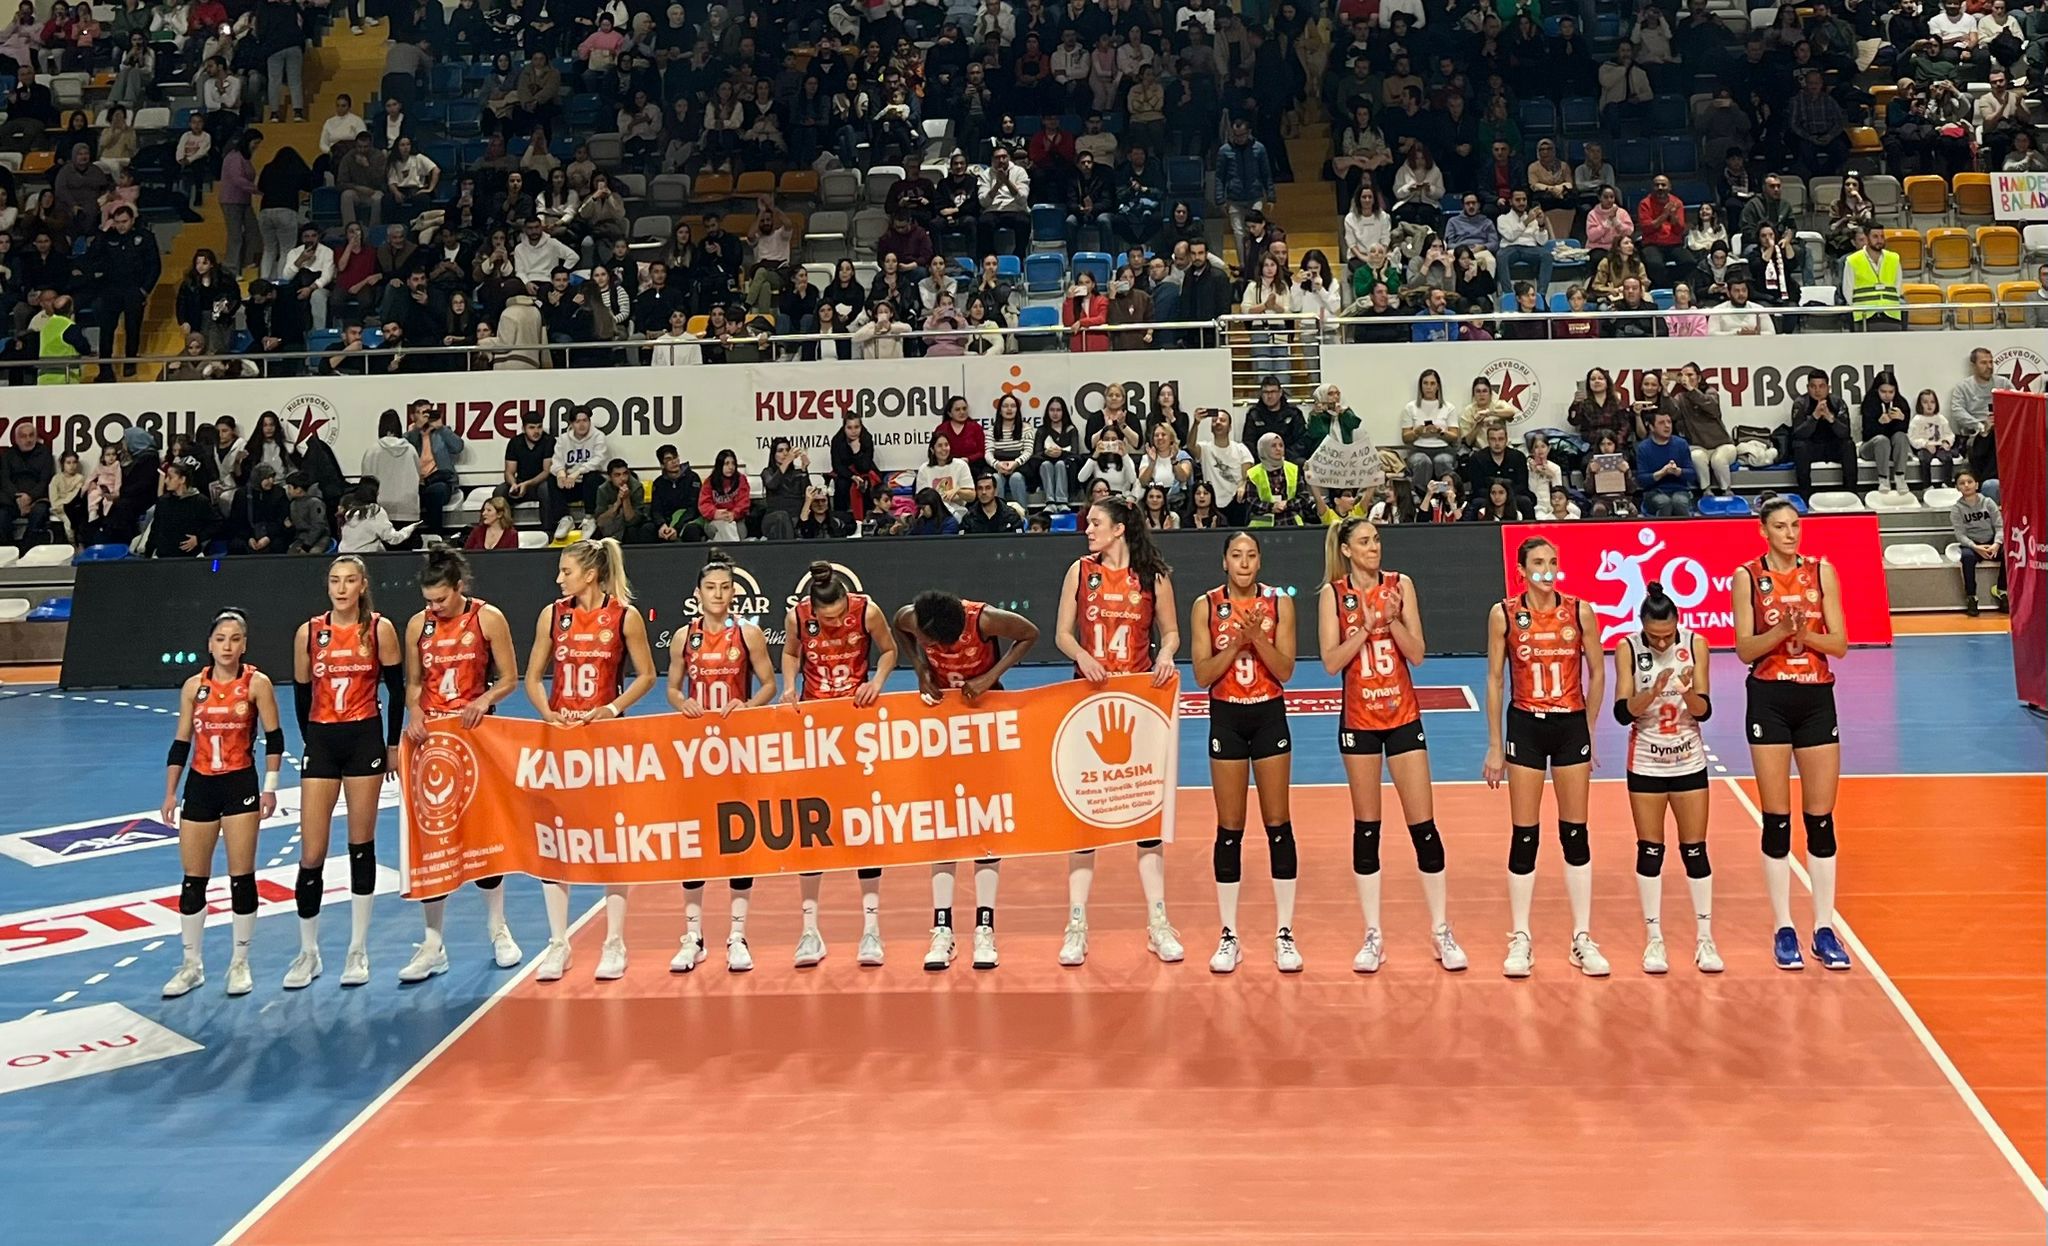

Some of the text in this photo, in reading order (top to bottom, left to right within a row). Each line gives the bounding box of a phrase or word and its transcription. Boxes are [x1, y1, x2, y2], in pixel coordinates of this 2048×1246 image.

[406, 395, 682, 441] UZEYBORU
[755, 386, 950, 421] KUZEYBORU
[874, 433, 900, 446] ILAR
[905, 428, 933, 444] DİLE
[566, 448, 591, 465] GAP
[1963, 510, 1991, 522] USPA
[1680, 611, 1733, 630] ULTAN
[1092, 623, 1130, 660] 14
[1234, 651, 1257, 687] 9
[1360, 639, 1395, 679] 15
[331, 677, 350, 712] 7
[438, 667, 460, 701] 4
[561, 663, 598, 699] 16
[696, 682, 730, 712] 10
[1531, 661, 1564, 699] 11
[560, 707, 591, 718] Dyna
[1659, 703, 1677, 735] 2
[210, 734, 224, 770] 1
[514, 707, 1022, 791] KADINA YÖNELİK ŞİDDETE
[1341, 732, 1355, 748] 15
[1650, 741, 1693, 756] Dynavit
[1081, 763, 1153, 783] 25 KASIM
[534, 783, 1016, 865] BİRLİKTE DUR DİYELİM!
[59, 830, 168, 856] AXA
[6, 1033, 139, 1068] ONU
